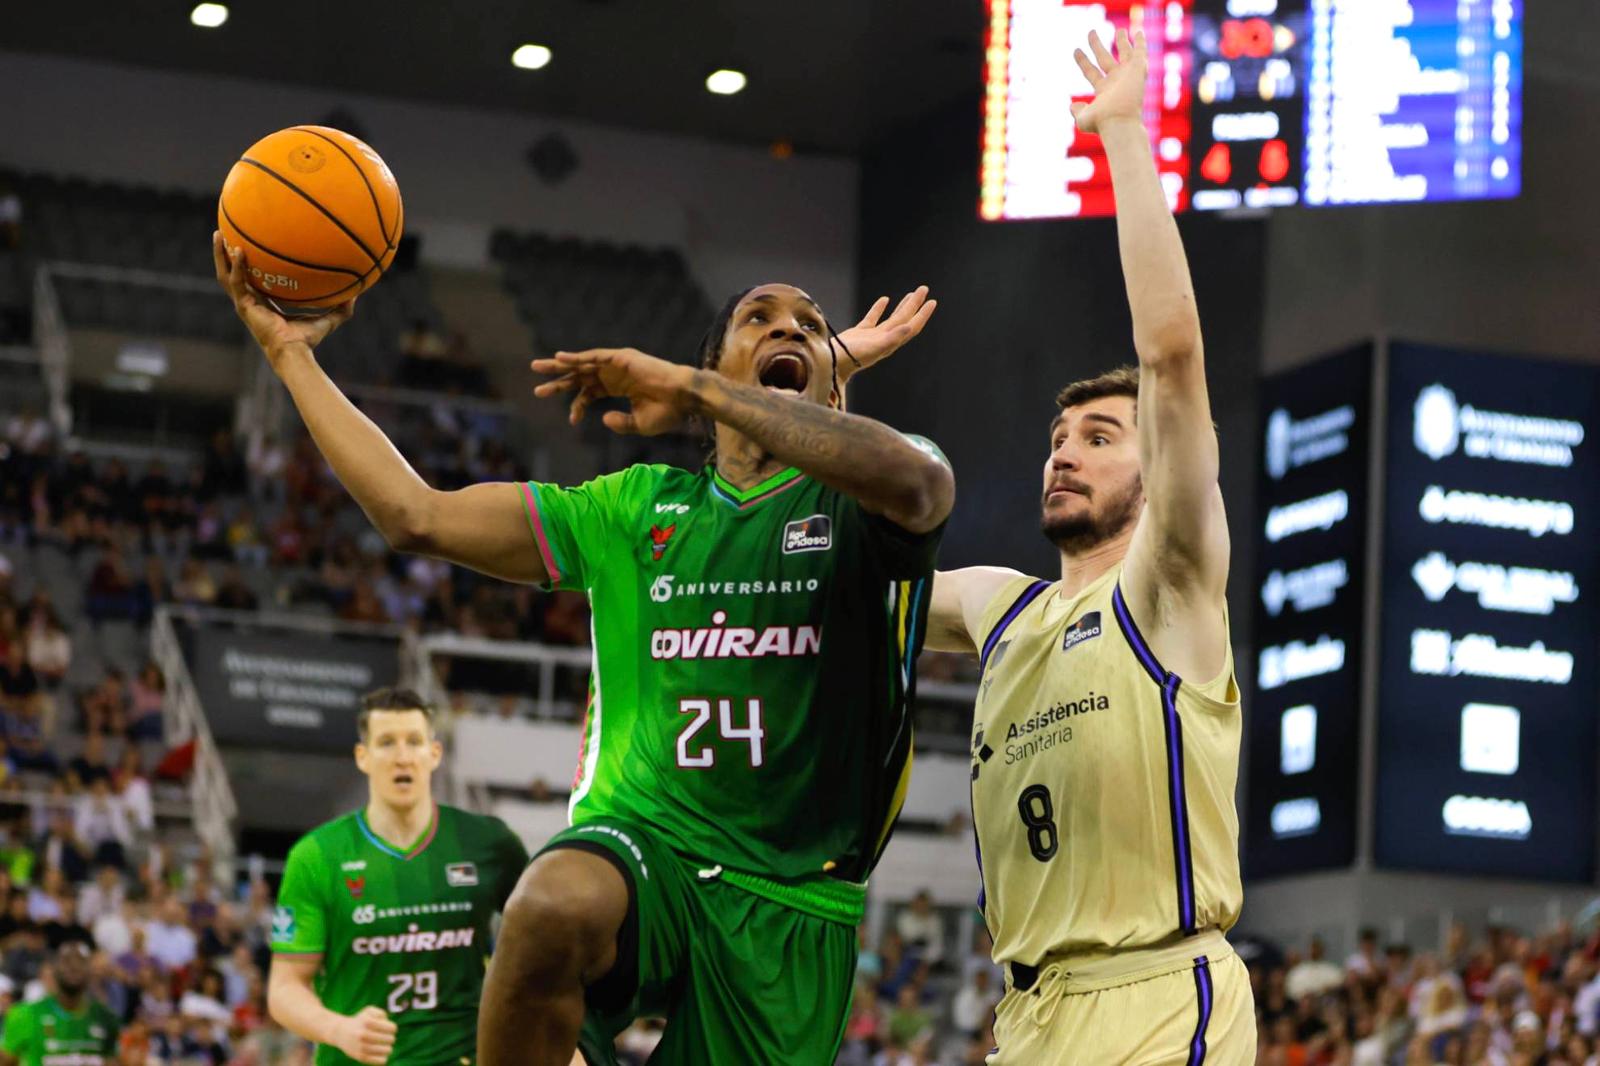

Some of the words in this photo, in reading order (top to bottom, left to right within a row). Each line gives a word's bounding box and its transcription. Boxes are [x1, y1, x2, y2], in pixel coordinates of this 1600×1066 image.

[676, 578, 818, 596] ANIVERSARIO
[676, 698, 764, 768] 24
[1005, 691, 1110, 742] Assistència
[1018, 784, 1059, 862] 8
[352, 904, 376, 925] 65
[386, 970, 438, 1013] 29
